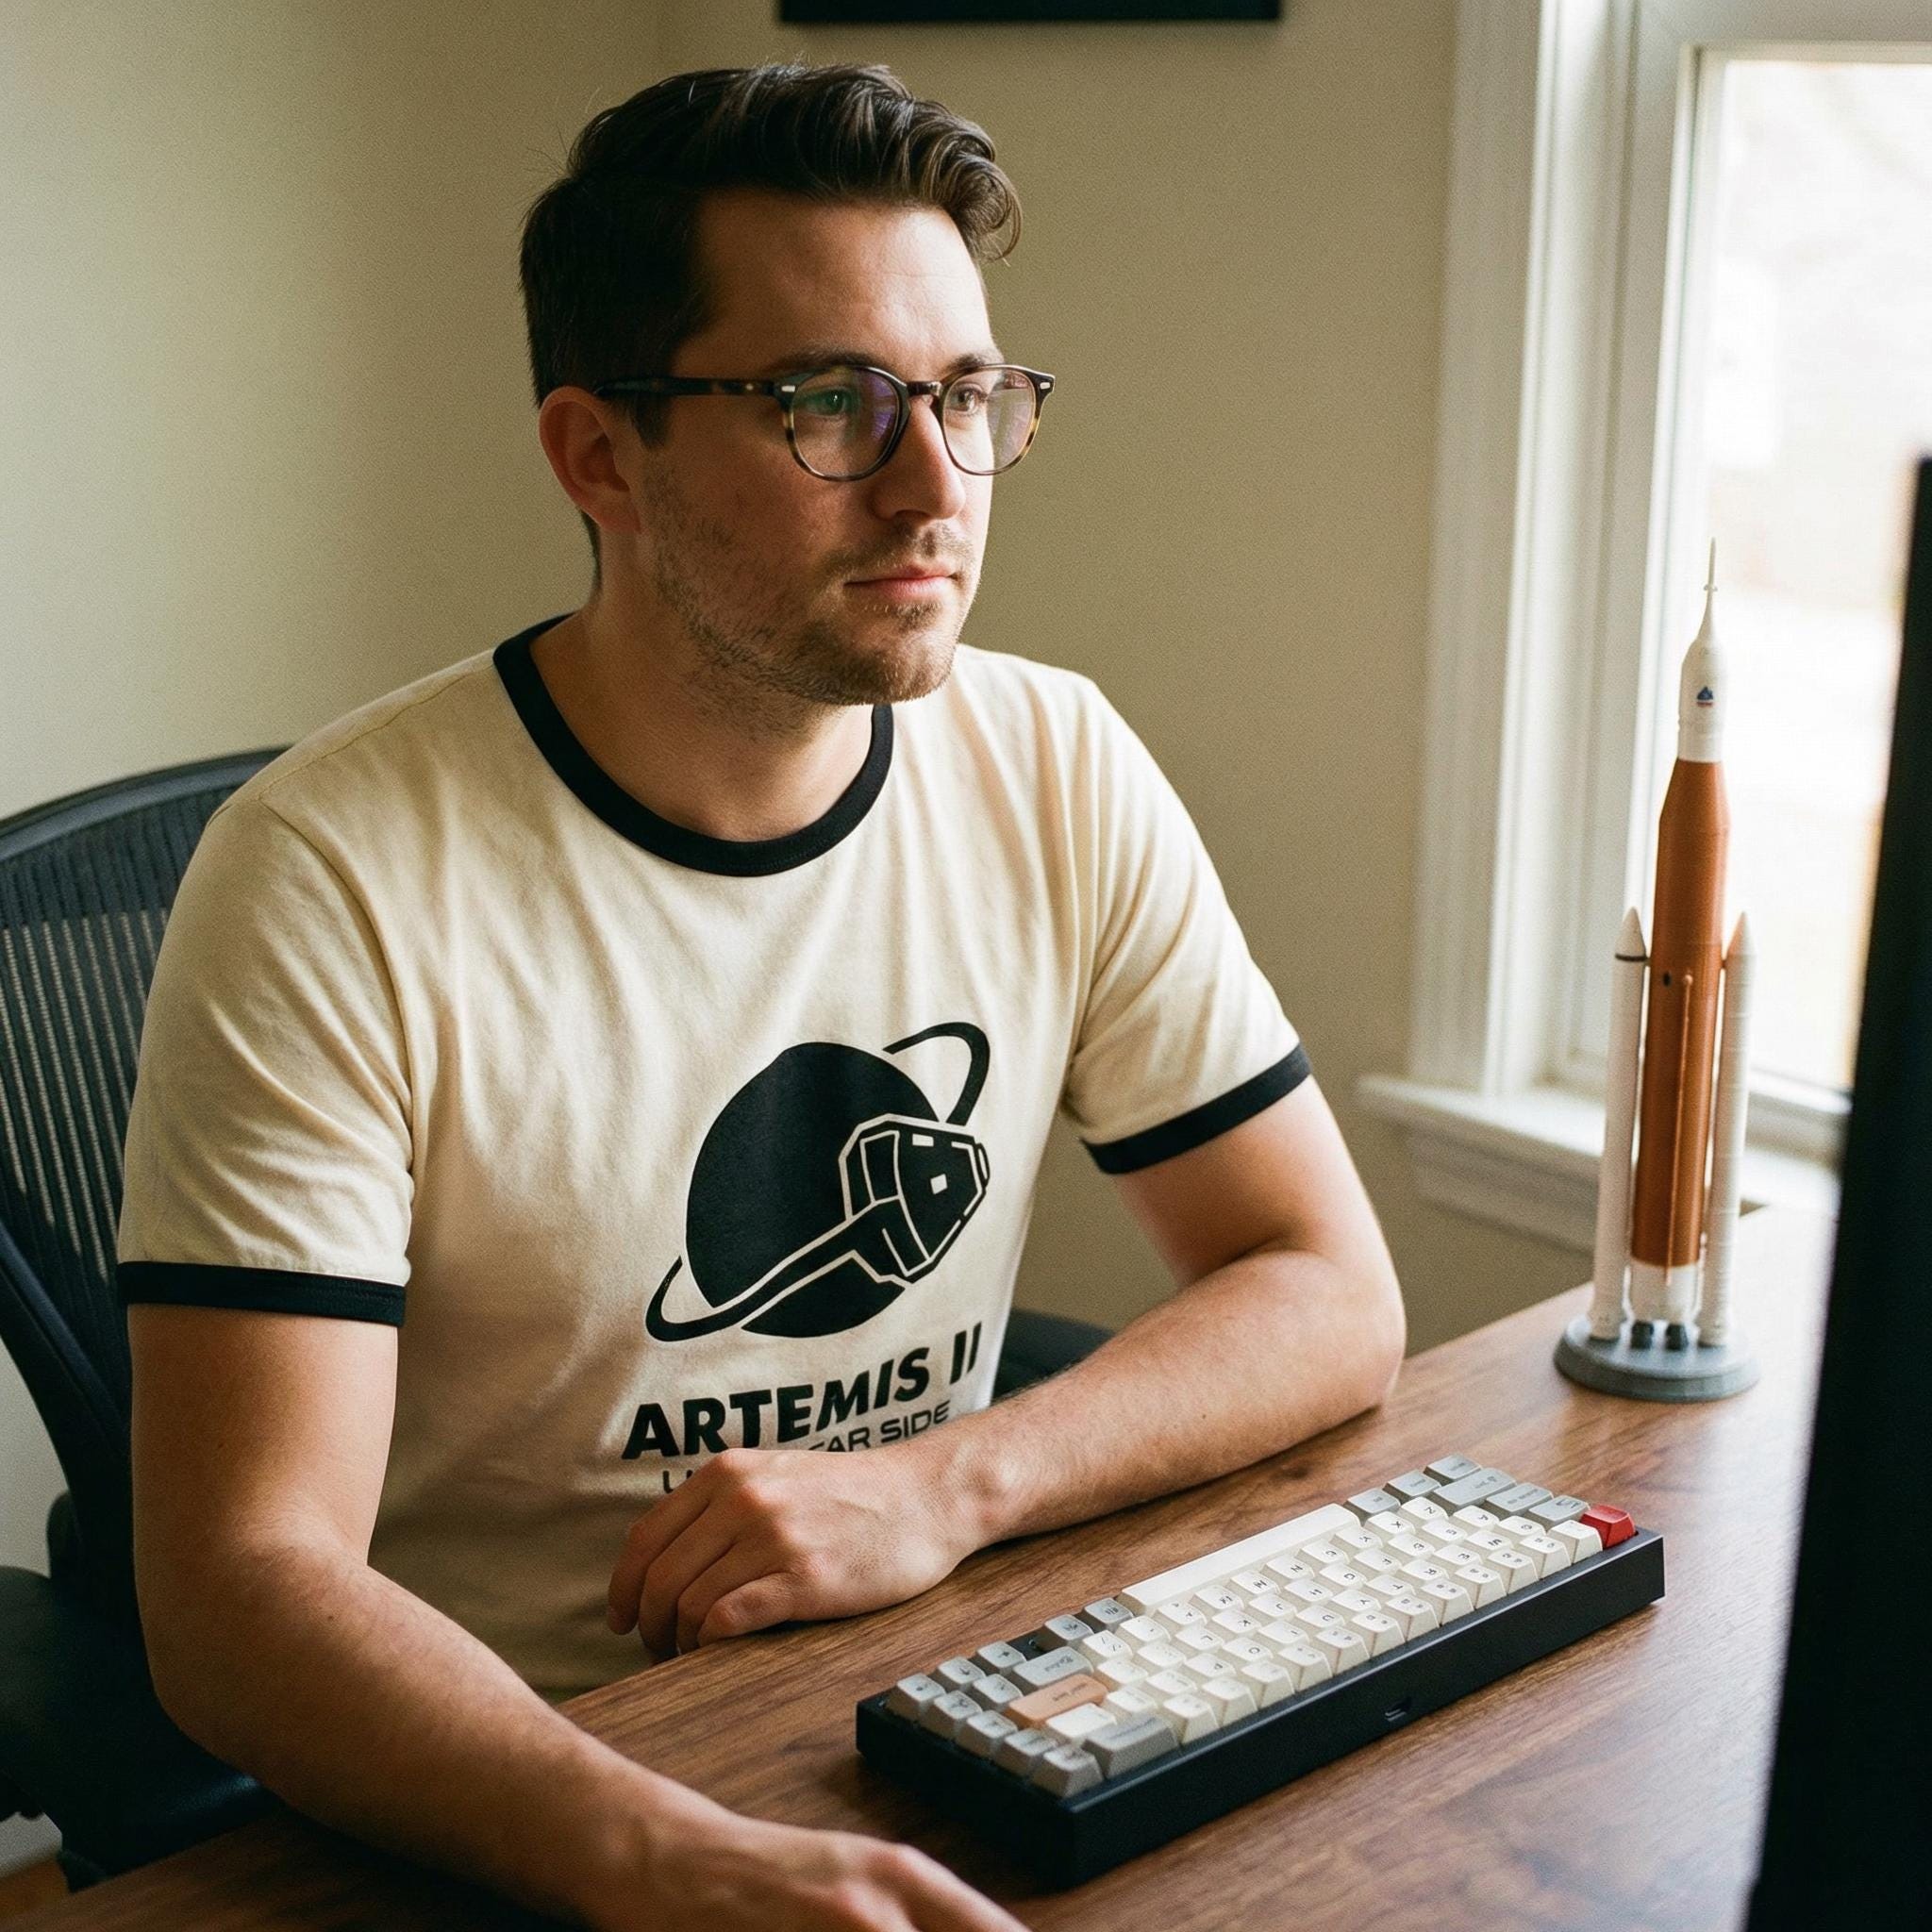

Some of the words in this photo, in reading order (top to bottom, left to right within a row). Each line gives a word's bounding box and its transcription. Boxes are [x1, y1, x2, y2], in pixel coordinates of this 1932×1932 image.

[621, 1346, 931, 1460] ARTEMIS
[948, 1322, 983, 1386] II
[880, 1399, 951, 1444] SIDE
